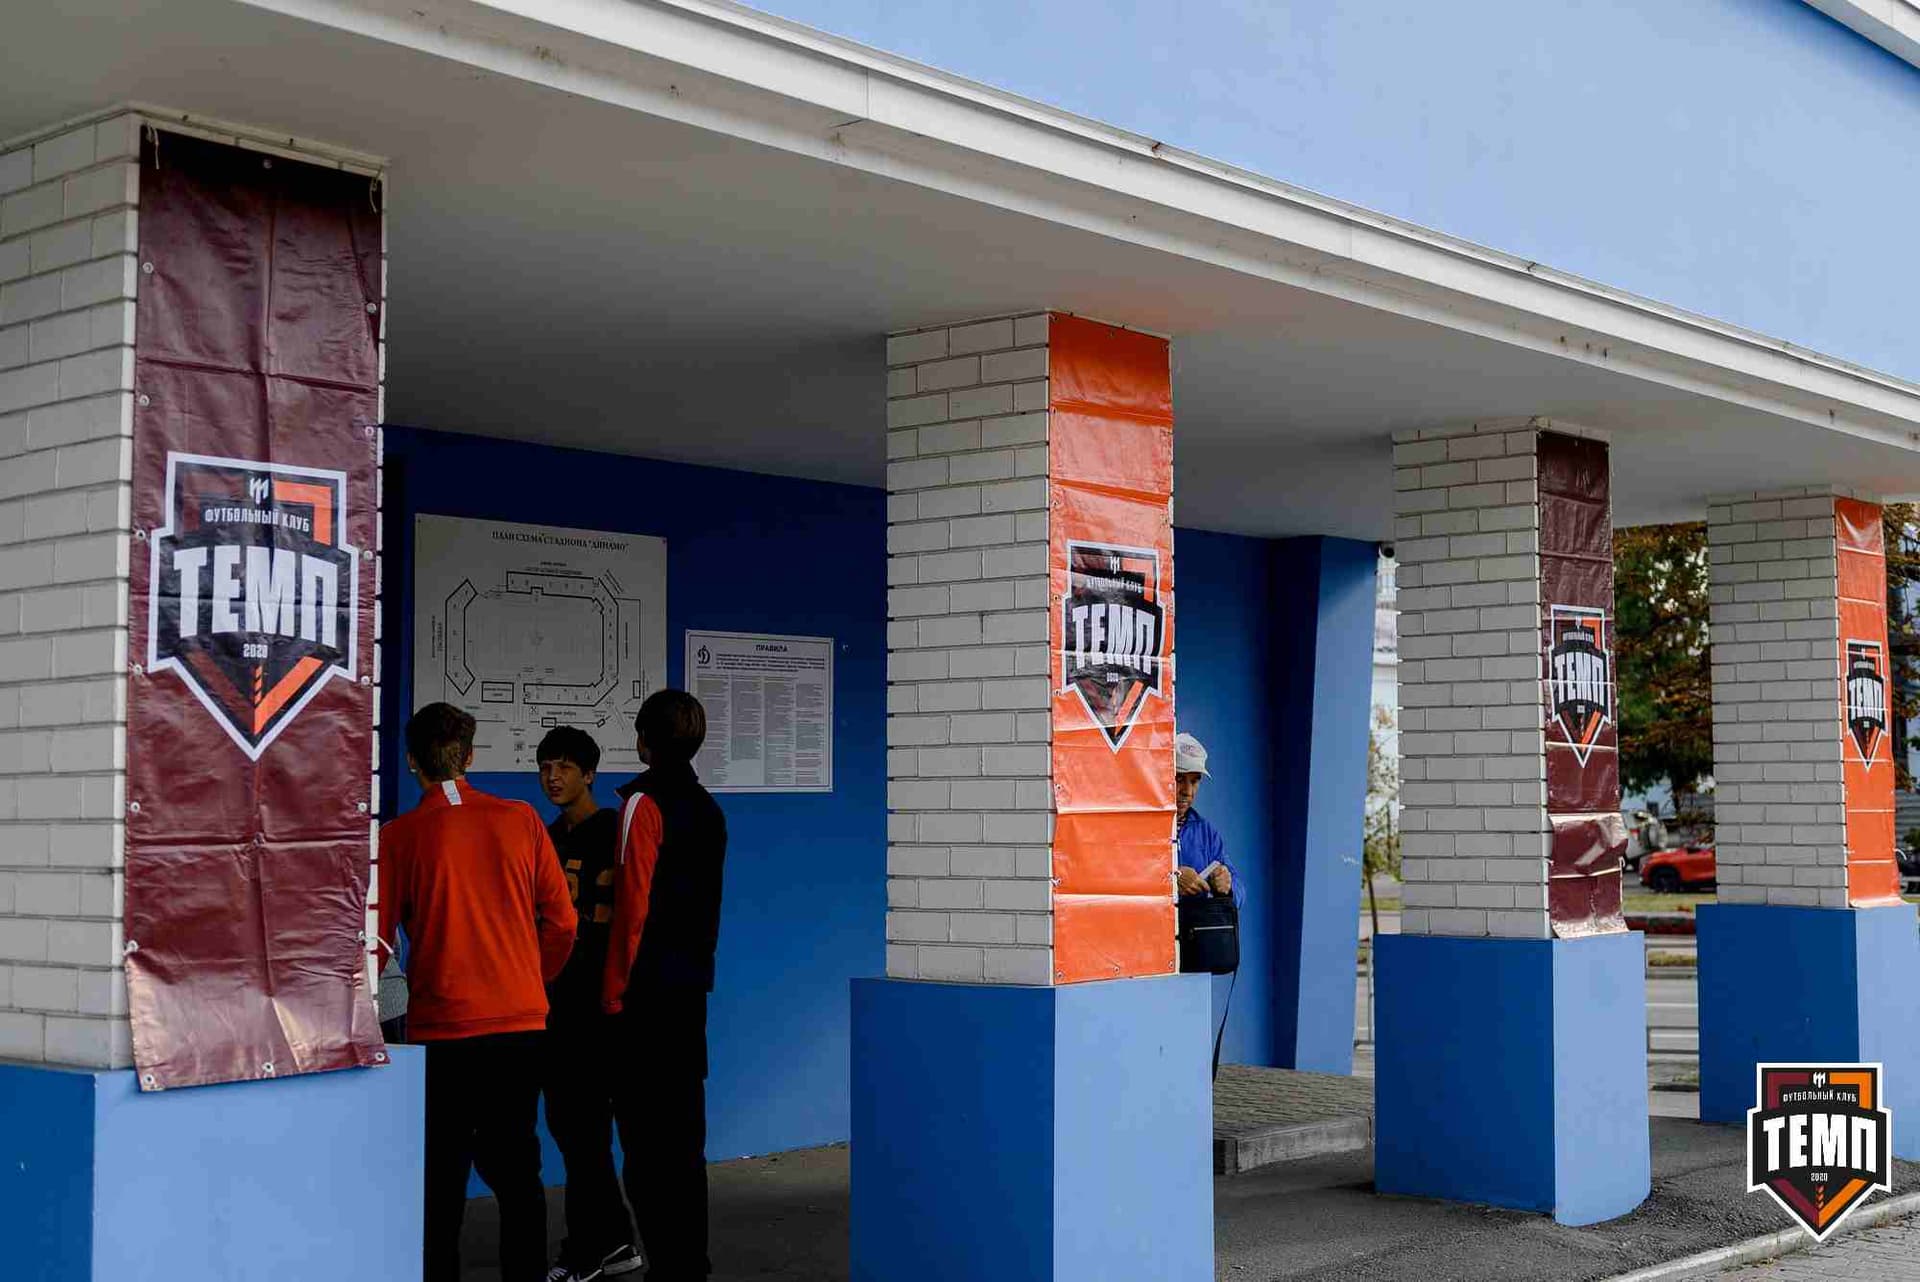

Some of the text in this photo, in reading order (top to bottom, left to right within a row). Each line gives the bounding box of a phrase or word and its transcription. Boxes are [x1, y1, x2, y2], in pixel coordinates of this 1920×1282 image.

[205, 507, 310, 532] ФУТБОЛЬНЫЙ КЛУБ
[173, 544, 338, 648] ТЕМП
[243, 643, 268, 659] 2020
[1072, 603, 1156, 675] ТЕМП
[1554, 651, 1605, 707] ТЕМП
